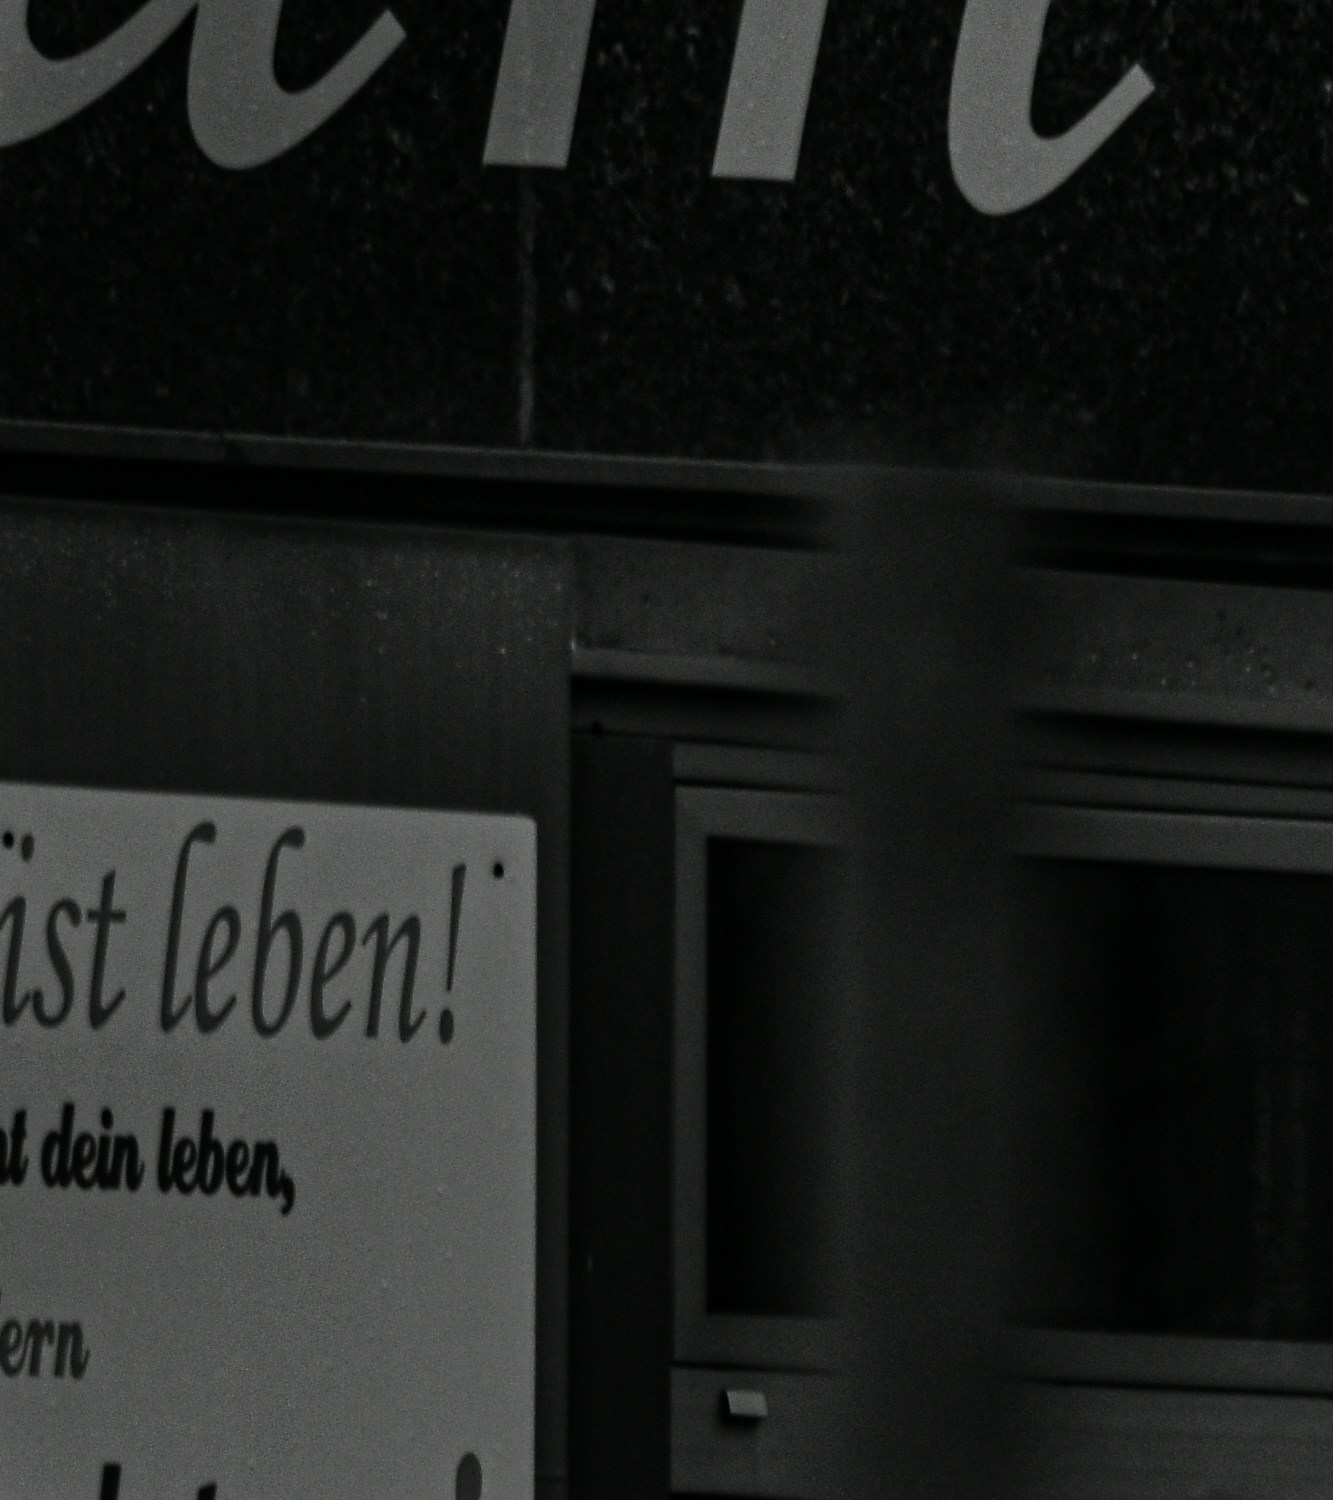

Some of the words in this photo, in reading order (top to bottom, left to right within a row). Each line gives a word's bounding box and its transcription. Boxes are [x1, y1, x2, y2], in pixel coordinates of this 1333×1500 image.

[158, 821, 467, 1046] leben!
[40, 1101, 145, 1192] dein
[156, 1106, 296, 1216] leben,
